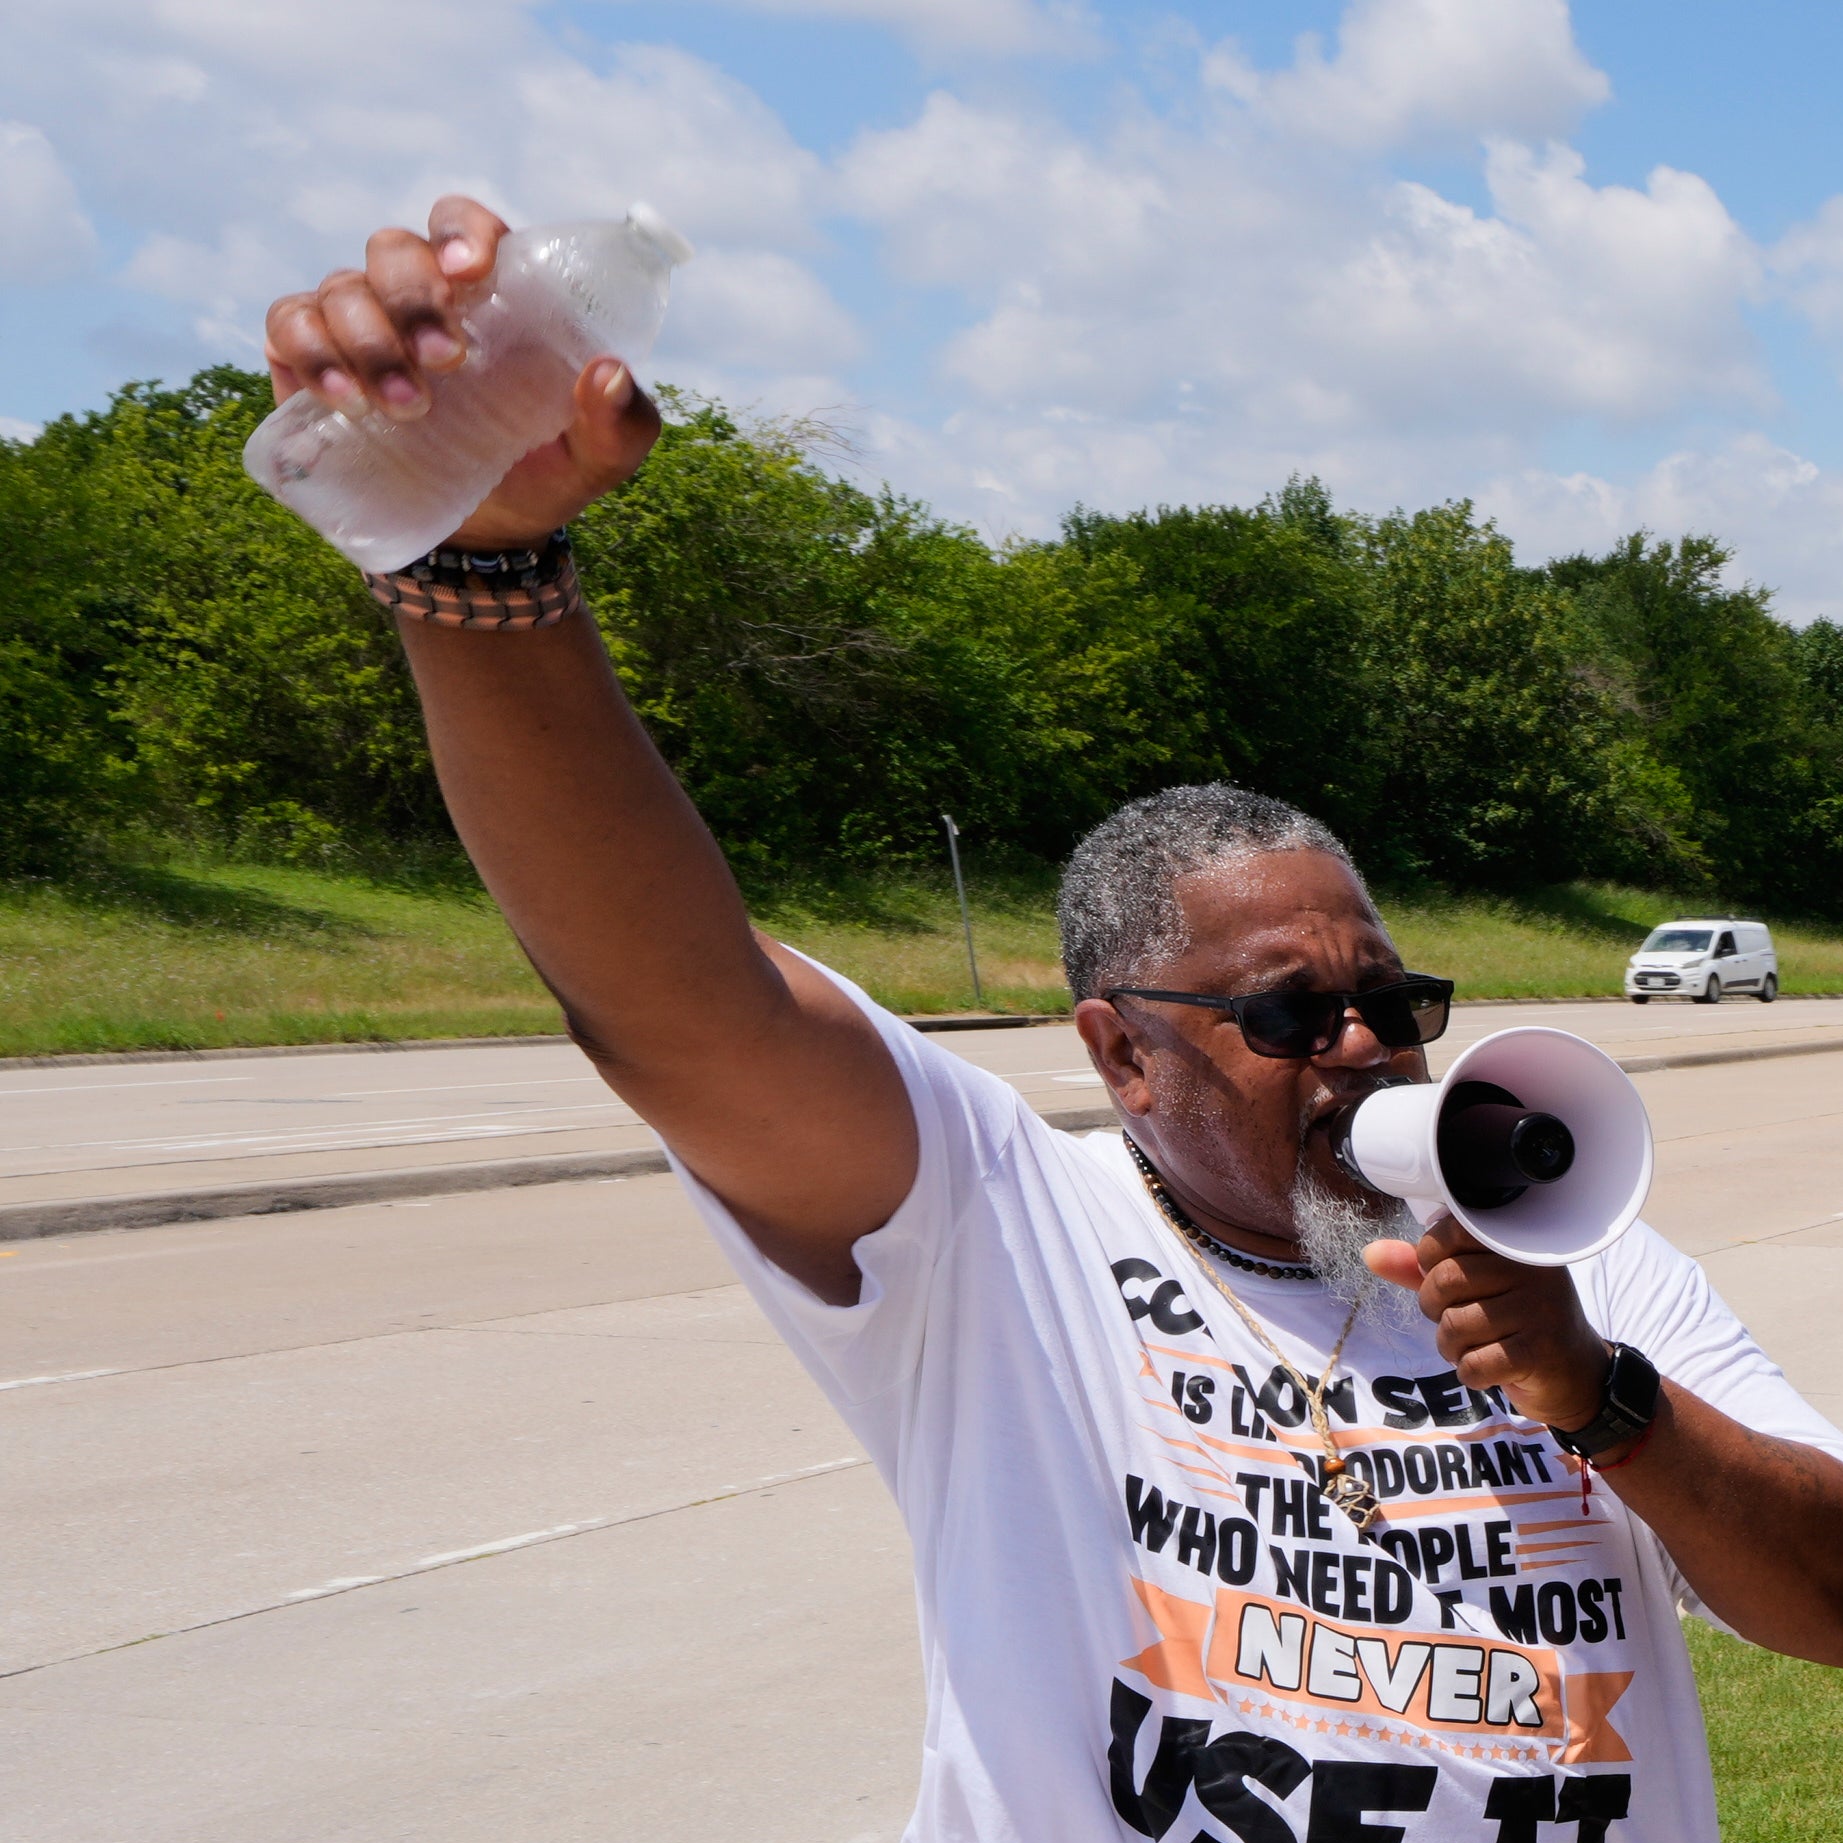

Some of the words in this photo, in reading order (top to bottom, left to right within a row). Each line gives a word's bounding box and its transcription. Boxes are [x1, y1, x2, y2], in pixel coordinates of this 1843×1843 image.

[1171, 1370, 1216, 1425] IS
[1235, 1471, 1334, 1541] THE
[1125, 1473, 1258, 1586] WHO
[1268, 1544, 1414, 1625] NEED
[1488, 1577, 1627, 1646] MOST
[1235, 1602, 1543, 1729] NEVER
